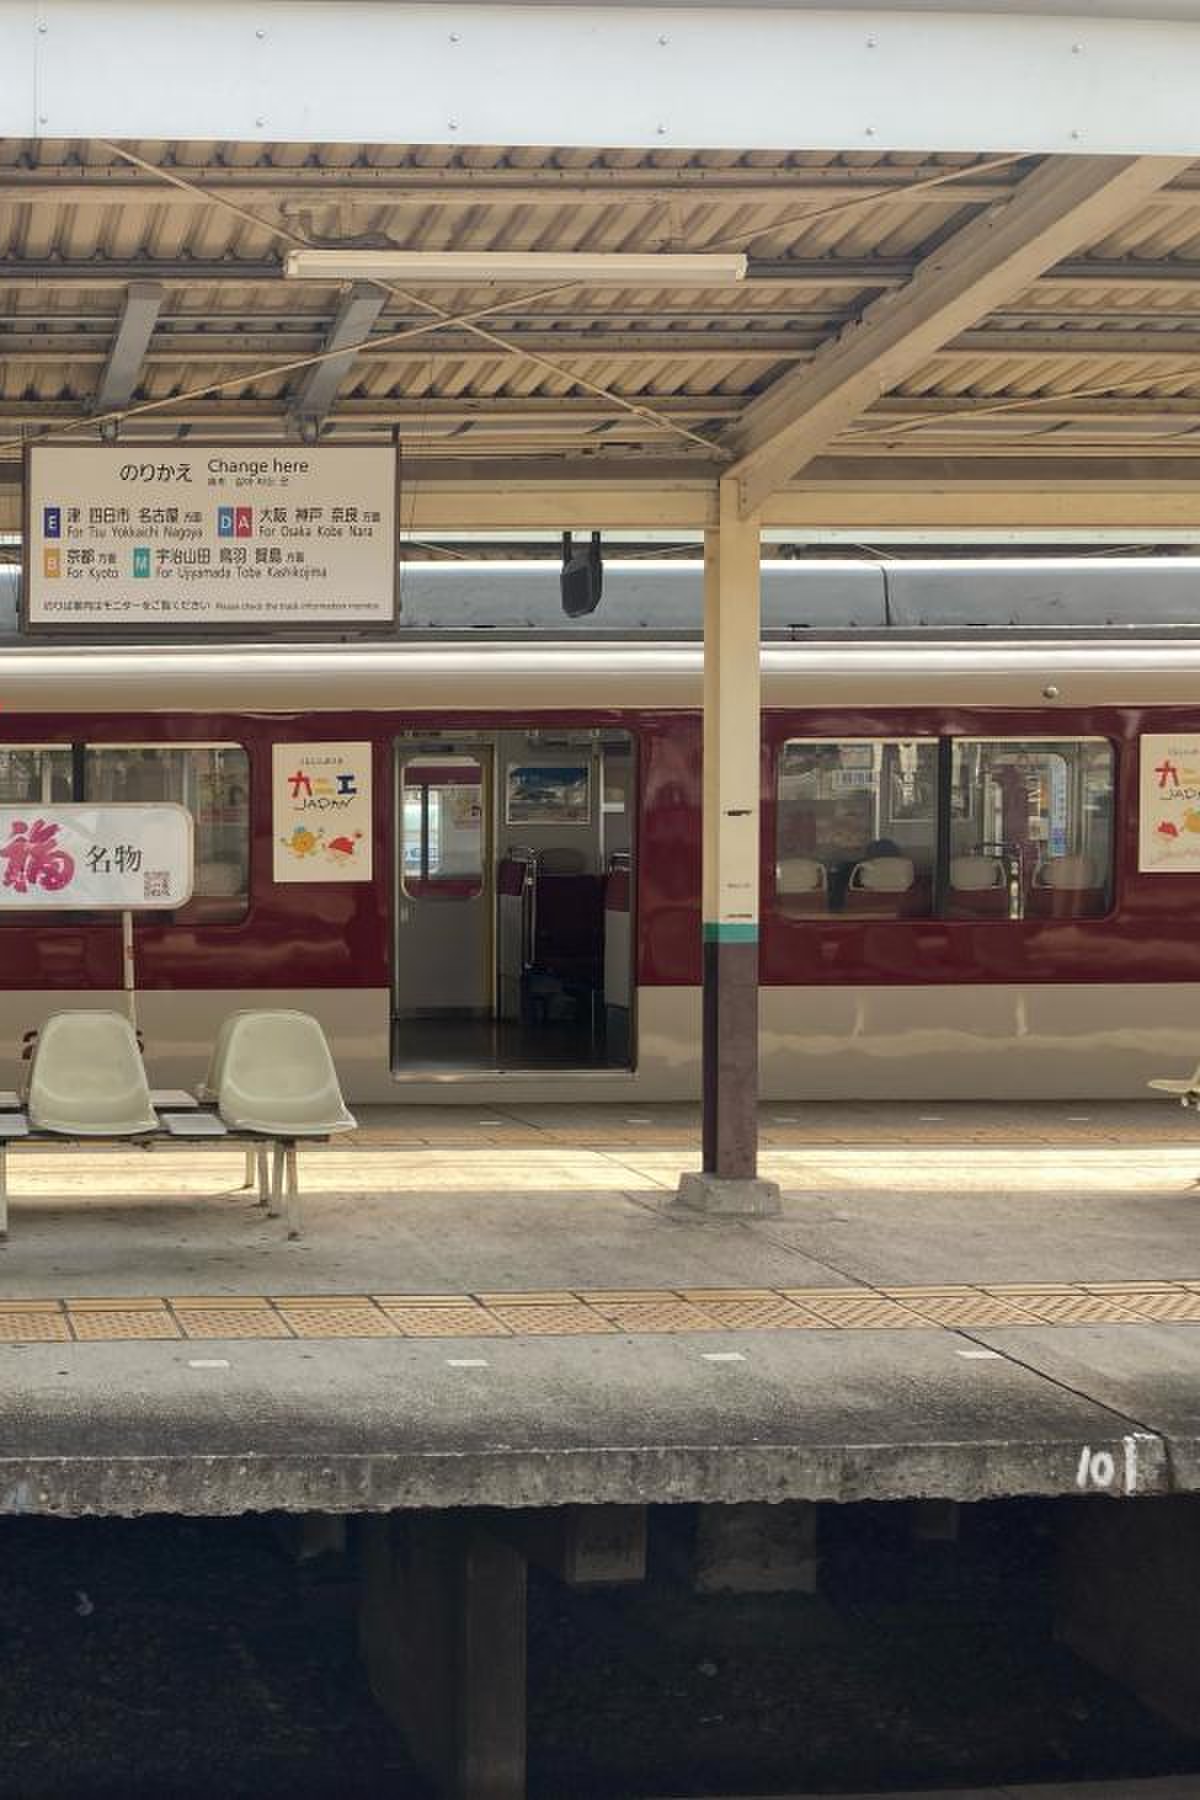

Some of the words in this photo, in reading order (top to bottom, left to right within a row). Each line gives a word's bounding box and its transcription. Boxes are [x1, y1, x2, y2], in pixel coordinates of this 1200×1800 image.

[119, 463, 193, 483] のりかえ
[207, 458, 268, 477] Change
[273, 458, 309, 473] here
[138, 507, 179, 523] 名古屋
[259, 507, 287, 523] 大阪
[295, 507, 324, 523] 神戸
[331, 507, 358, 523] 奈良
[67, 526, 82, 538] For
[259, 525, 277, 537] For
[281, 525, 311, 537] Osaka
[350, 525, 373, 537] Nara
[67, 548, 95, 564] 京都
[156, 548, 211, 564] 宇治山田
[67, 567, 82, 578] For
[89, 567, 119, 581] Kyoto
[157, 567, 173, 578] For
[85, 845, 143, 874] 名物
